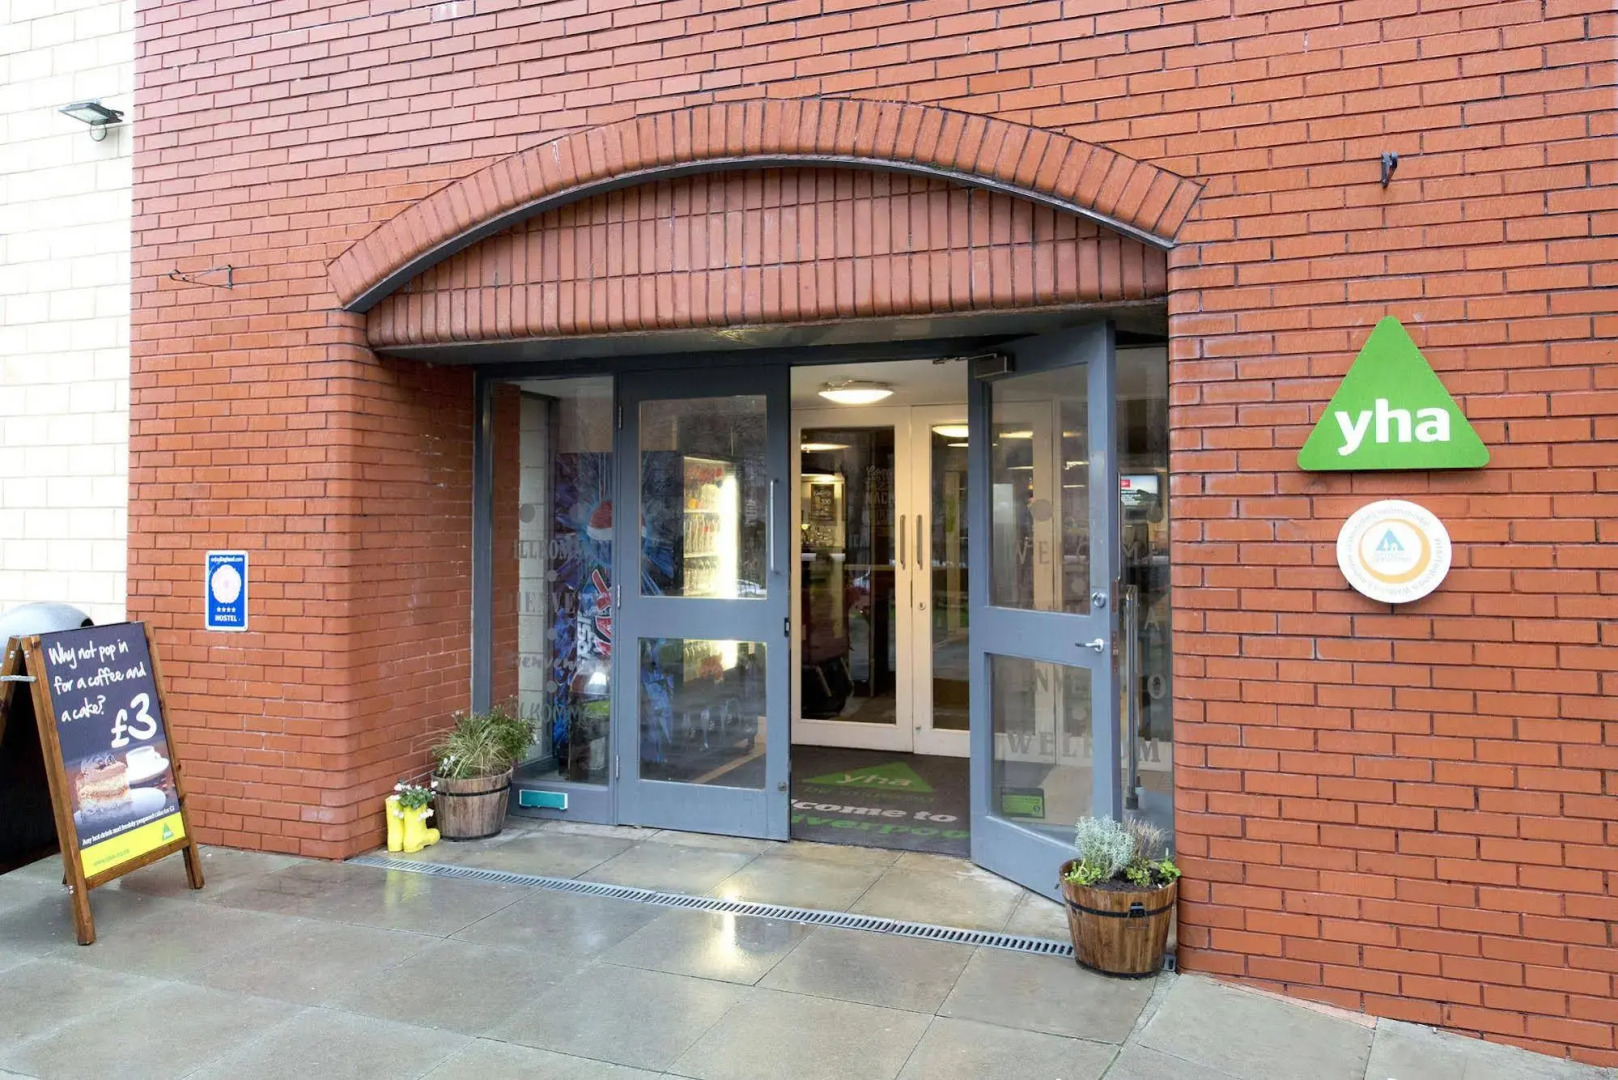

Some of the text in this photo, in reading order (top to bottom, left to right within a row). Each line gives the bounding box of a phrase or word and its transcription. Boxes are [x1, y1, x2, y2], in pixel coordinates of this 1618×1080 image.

[1334, 398, 1451, 456] yha
[214, 614, 238, 622] HOSTEL
[48, 639, 129, 670] Why not pop in
[53, 661, 147, 696] for a coffee and
[61, 695, 107, 723] a cake?
[111, 693, 157, 748] £3
[836, 773, 912, 787] yha
[913, 810, 959, 823] to
